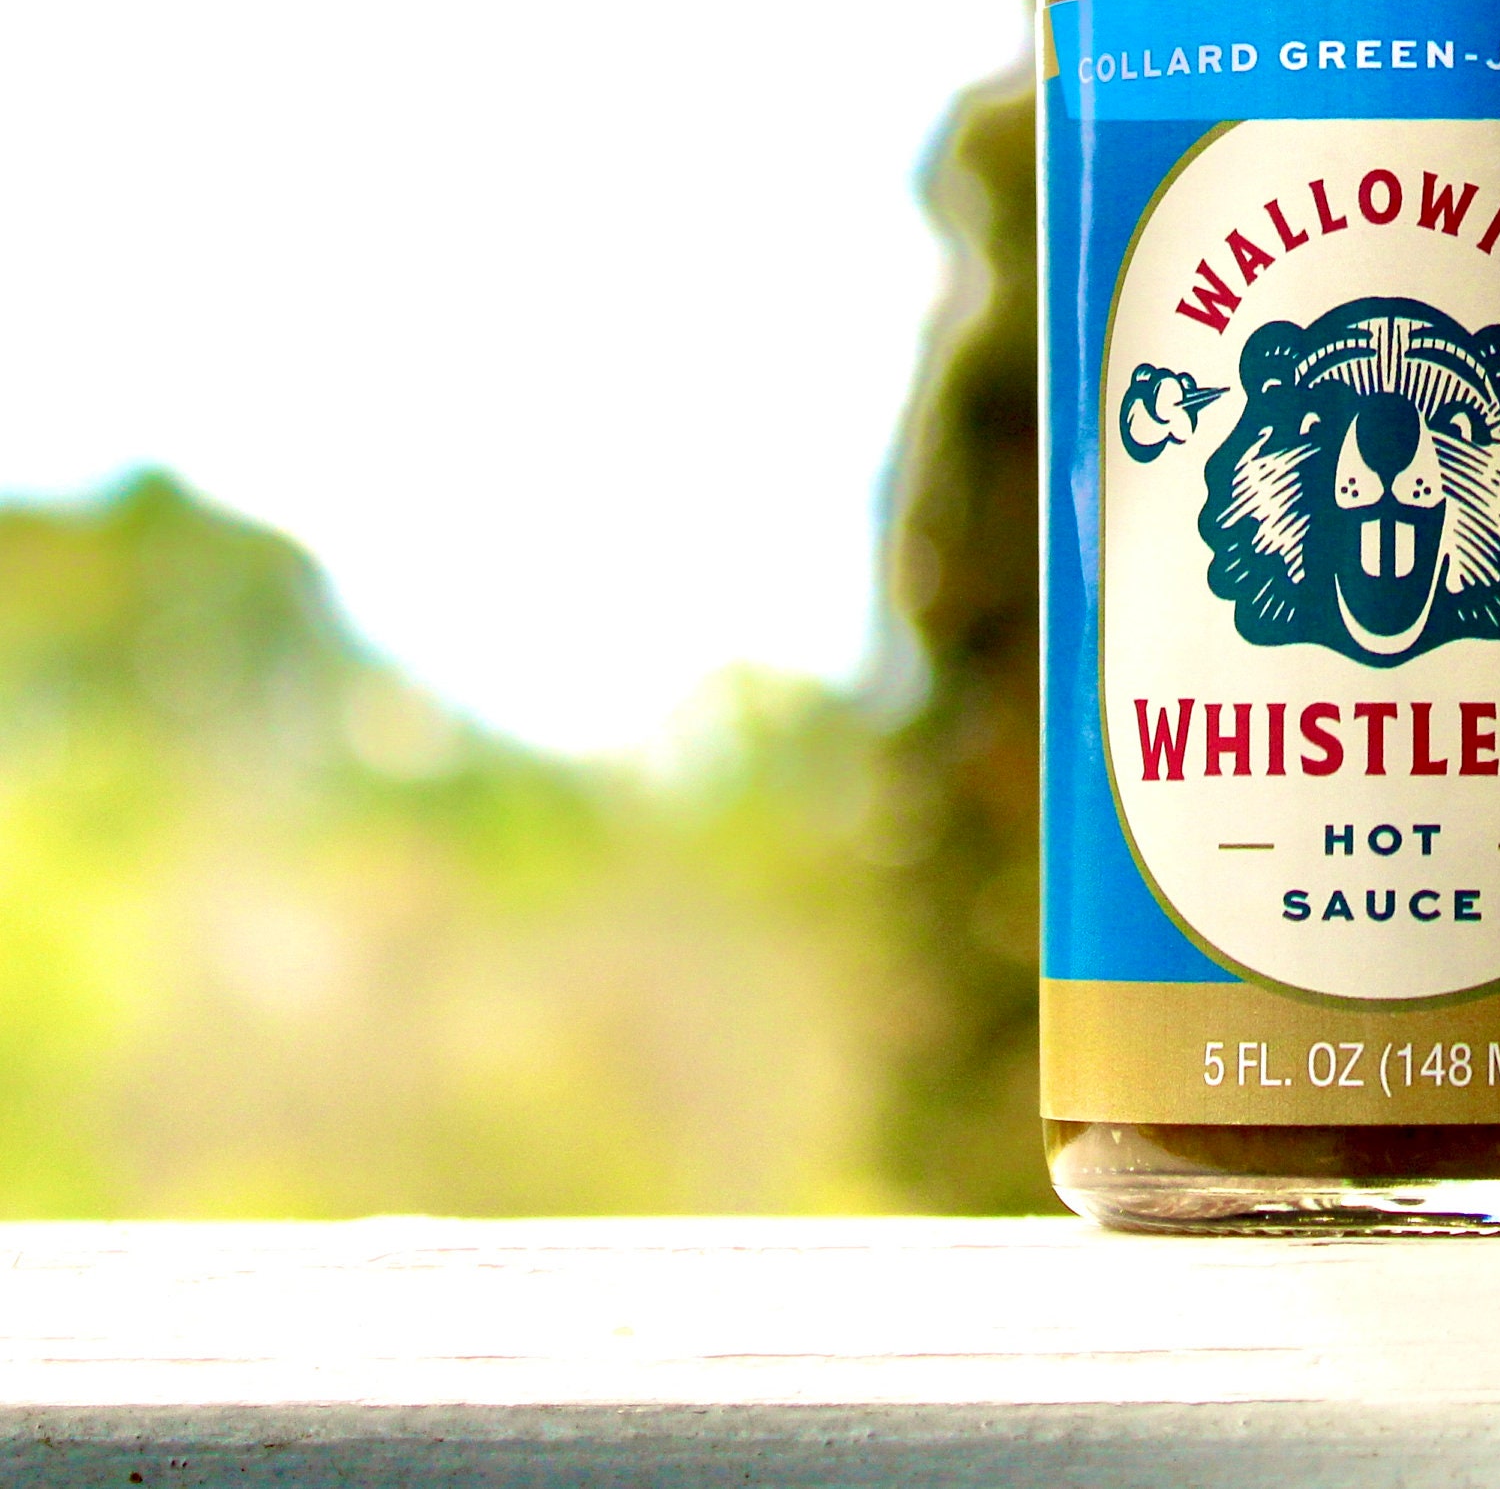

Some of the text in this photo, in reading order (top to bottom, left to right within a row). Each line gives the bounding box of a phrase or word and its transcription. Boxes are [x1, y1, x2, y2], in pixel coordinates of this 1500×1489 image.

[1078, 42, 1259, 84] COLLARD
[1324, 824, 1442, 856] HOT
[1282, 889, 1483, 922] SAUCE
[1203, 1041, 1225, 1087] 5
[1237, 1042, 1292, 1087] FL.
[1306, 1042, 1365, 1087] OZ
[1379, 1041, 1473, 1098] (148
